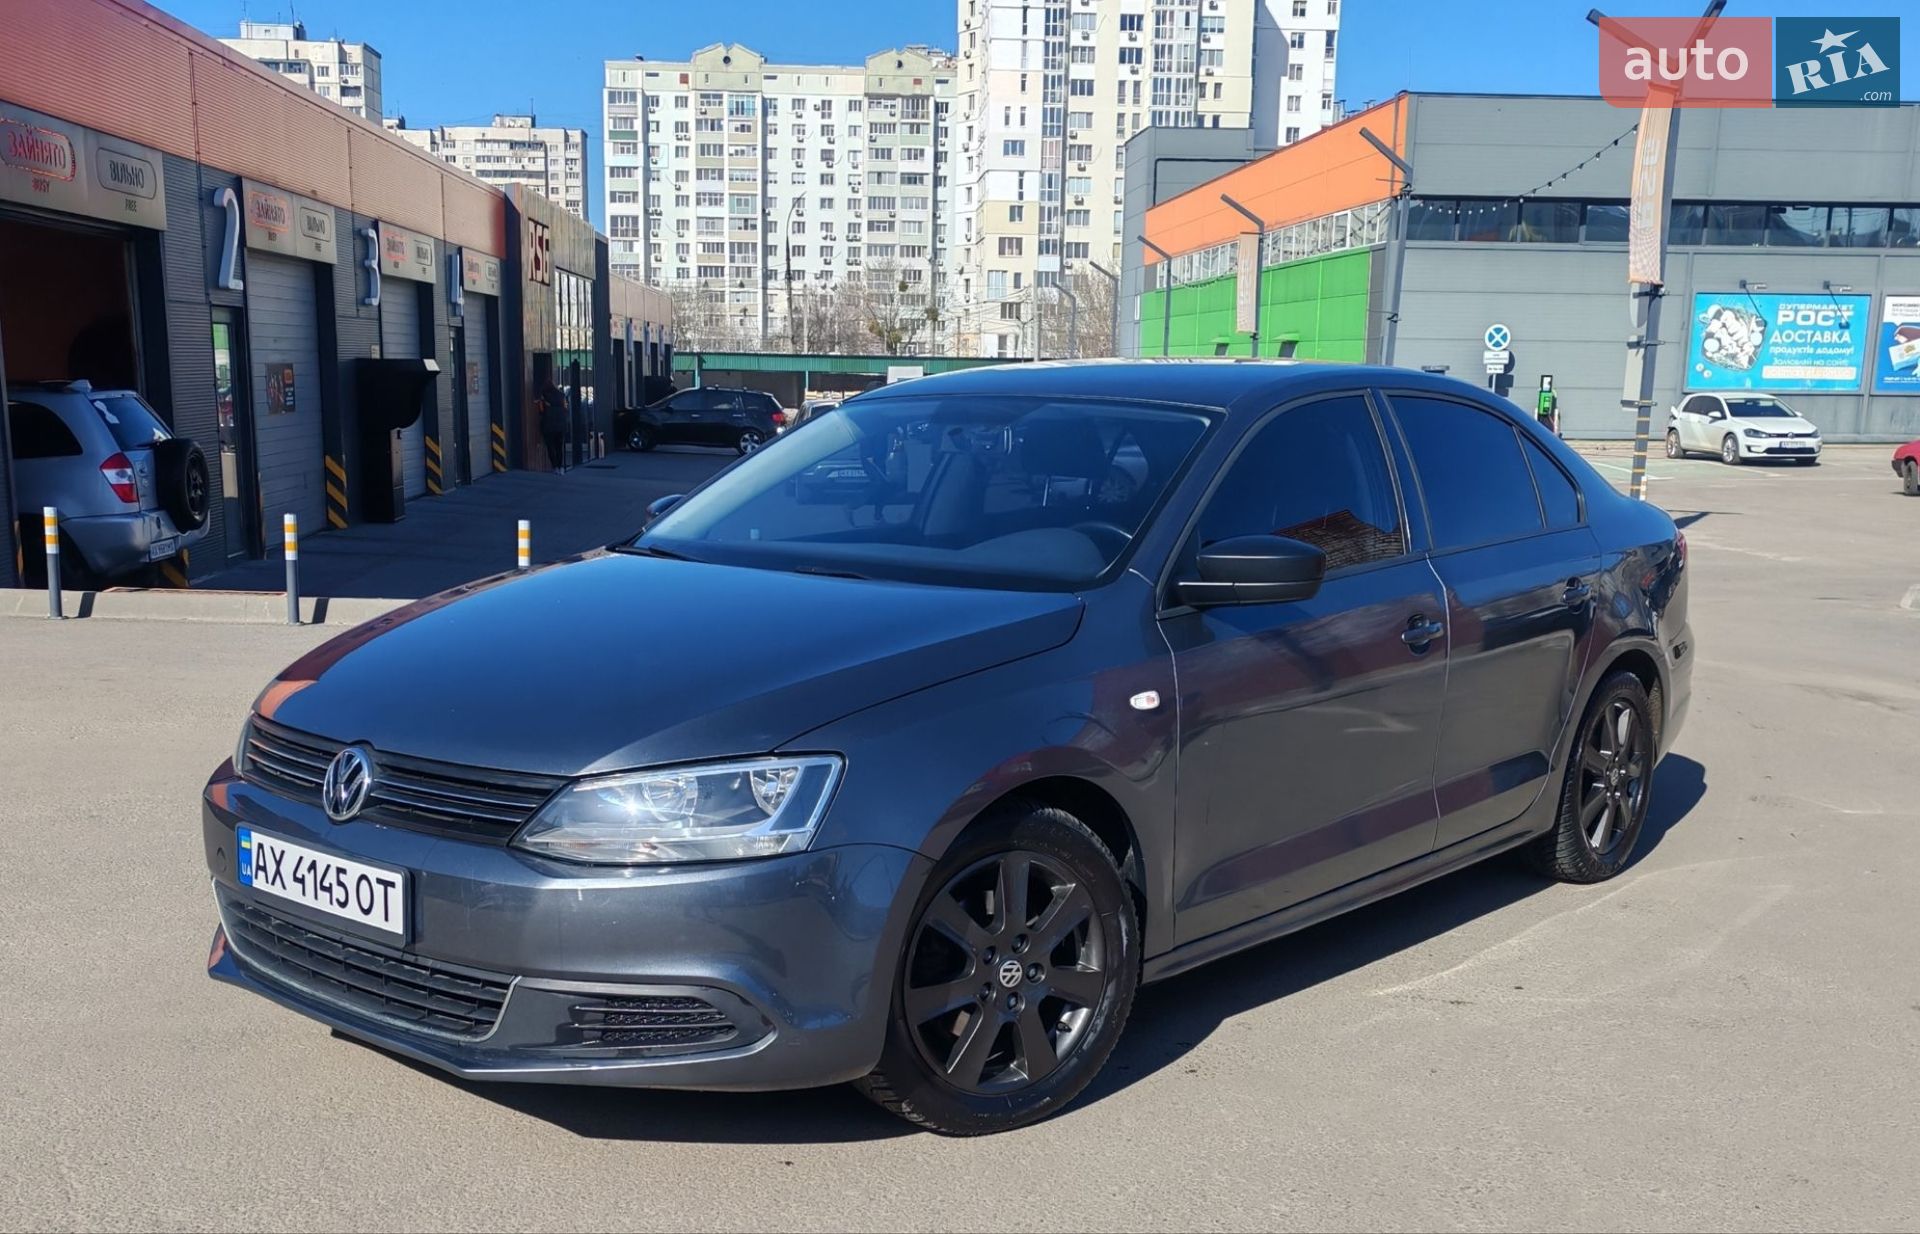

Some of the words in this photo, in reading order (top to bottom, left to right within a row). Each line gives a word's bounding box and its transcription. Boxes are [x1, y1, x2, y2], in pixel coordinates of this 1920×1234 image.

[8, 128, 67, 169] ЗАЙНЯТО
[109, 159, 145, 189] ВІЛЬНО
[214, 187, 244, 290] 2
[361, 228, 381, 306] 3
[1769, 330, 1851, 344] ДОСТАВКА
[1777, 310, 1854, 326] РОСТ
[255, 842, 286, 890] AX
[292, 855, 349, 909] 4145
[356, 873, 396, 922] OT
